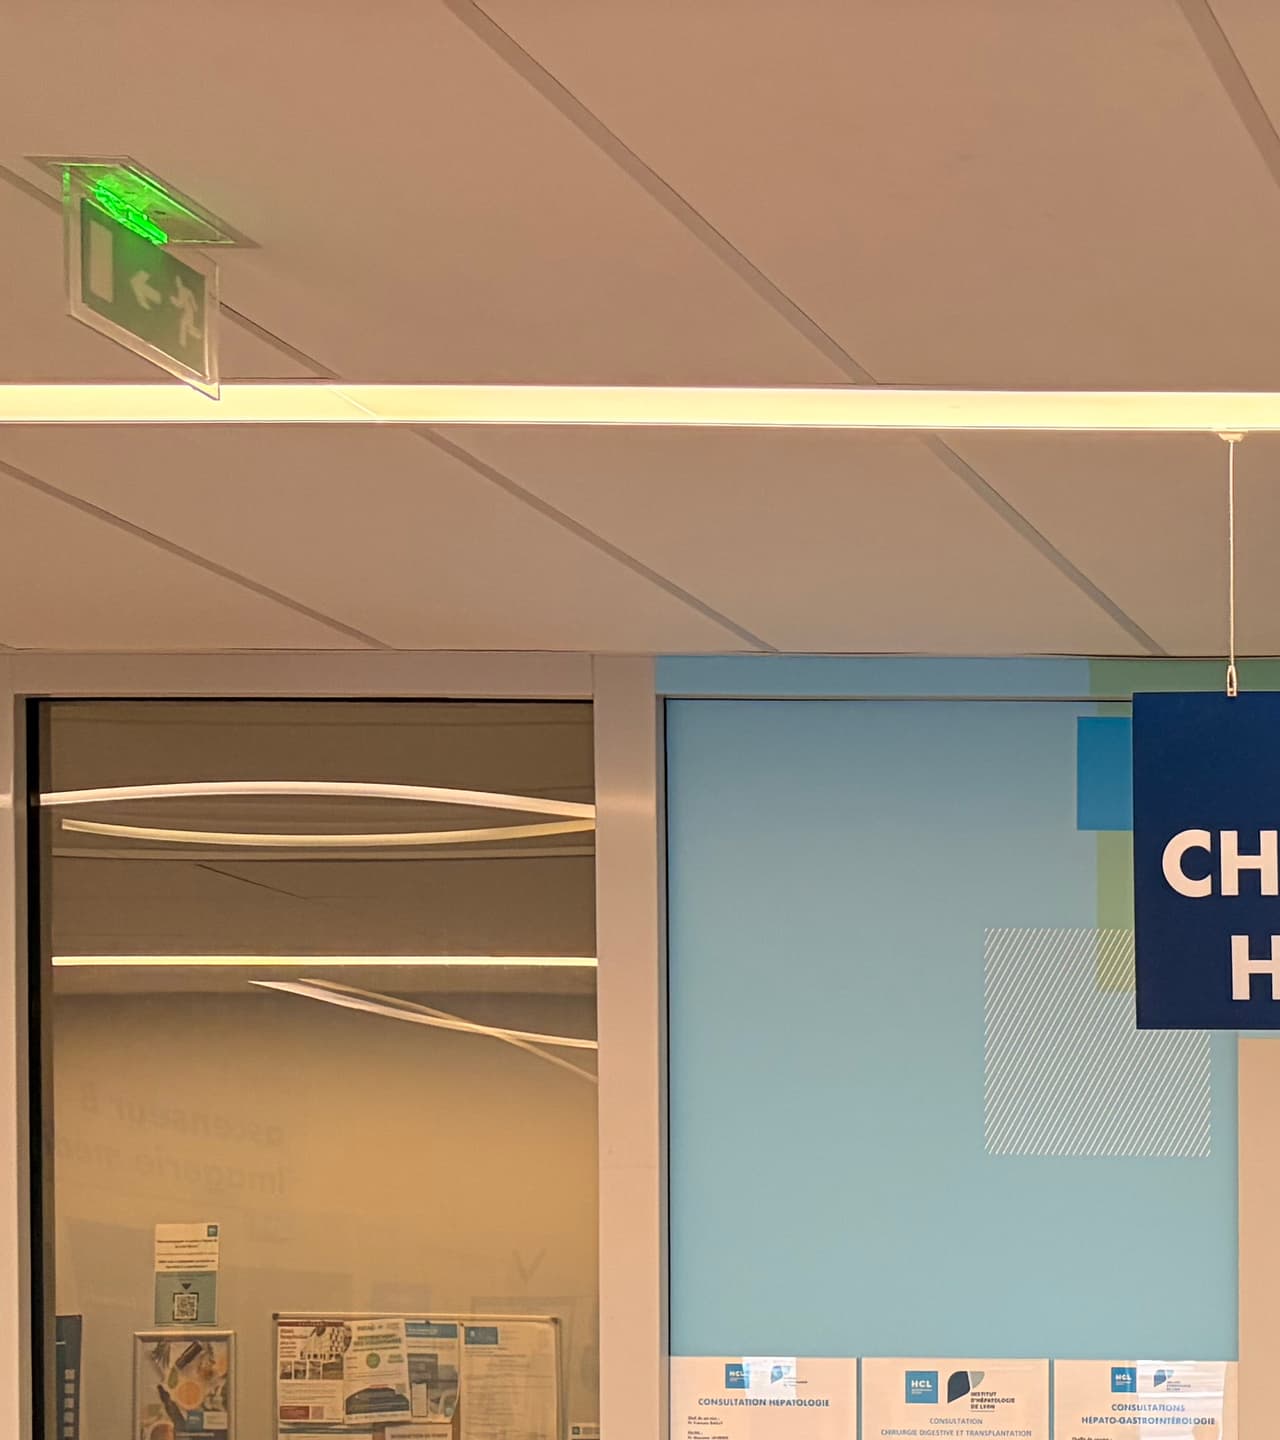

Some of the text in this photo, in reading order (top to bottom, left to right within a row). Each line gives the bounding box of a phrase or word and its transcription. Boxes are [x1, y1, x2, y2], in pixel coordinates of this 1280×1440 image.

[911, 1379, 933, 1388] HCL
[698, 1398, 767, 1407] CONSULTATION
[1111, 1403, 1185, 1412] CONSULTATIONS
